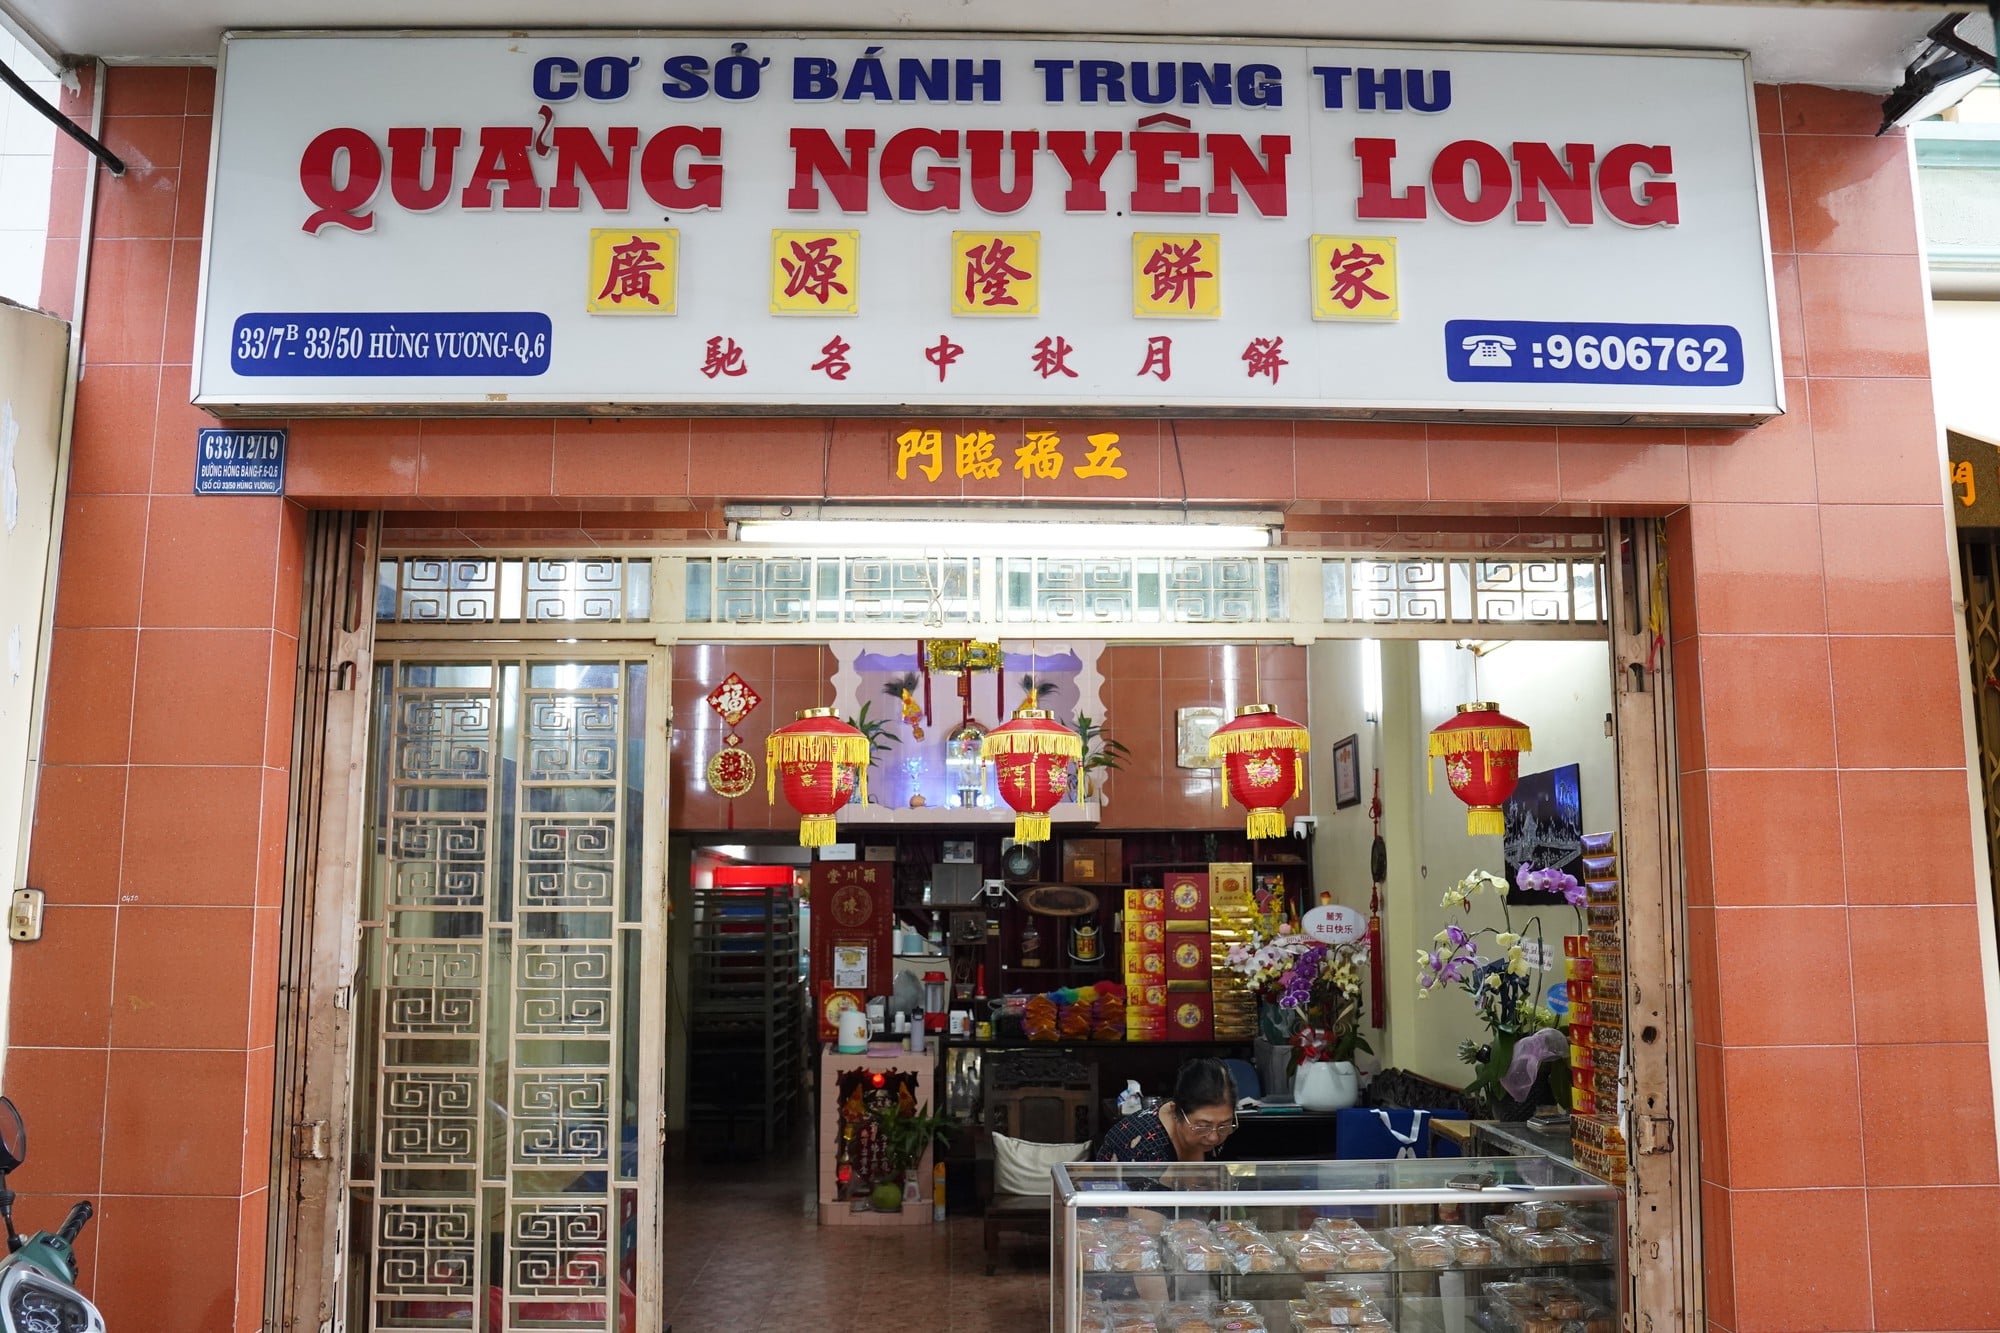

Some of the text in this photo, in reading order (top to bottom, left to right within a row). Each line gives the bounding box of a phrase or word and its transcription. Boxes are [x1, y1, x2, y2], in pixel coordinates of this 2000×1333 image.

[534, 43, 1453, 113] CƠ SỞ BÁNH TRUNG THU
[300, 106, 1679, 236] QUẢNG NGUYÊN LONG
[303, 326, 363, 359] 33/50
[368, 325, 429, 358] HÙNG
[205, 434, 279, 460] 633/12/19
[718, 683, 746, 712] 福
[1316, 923, 1353, 935] 生日快乐
